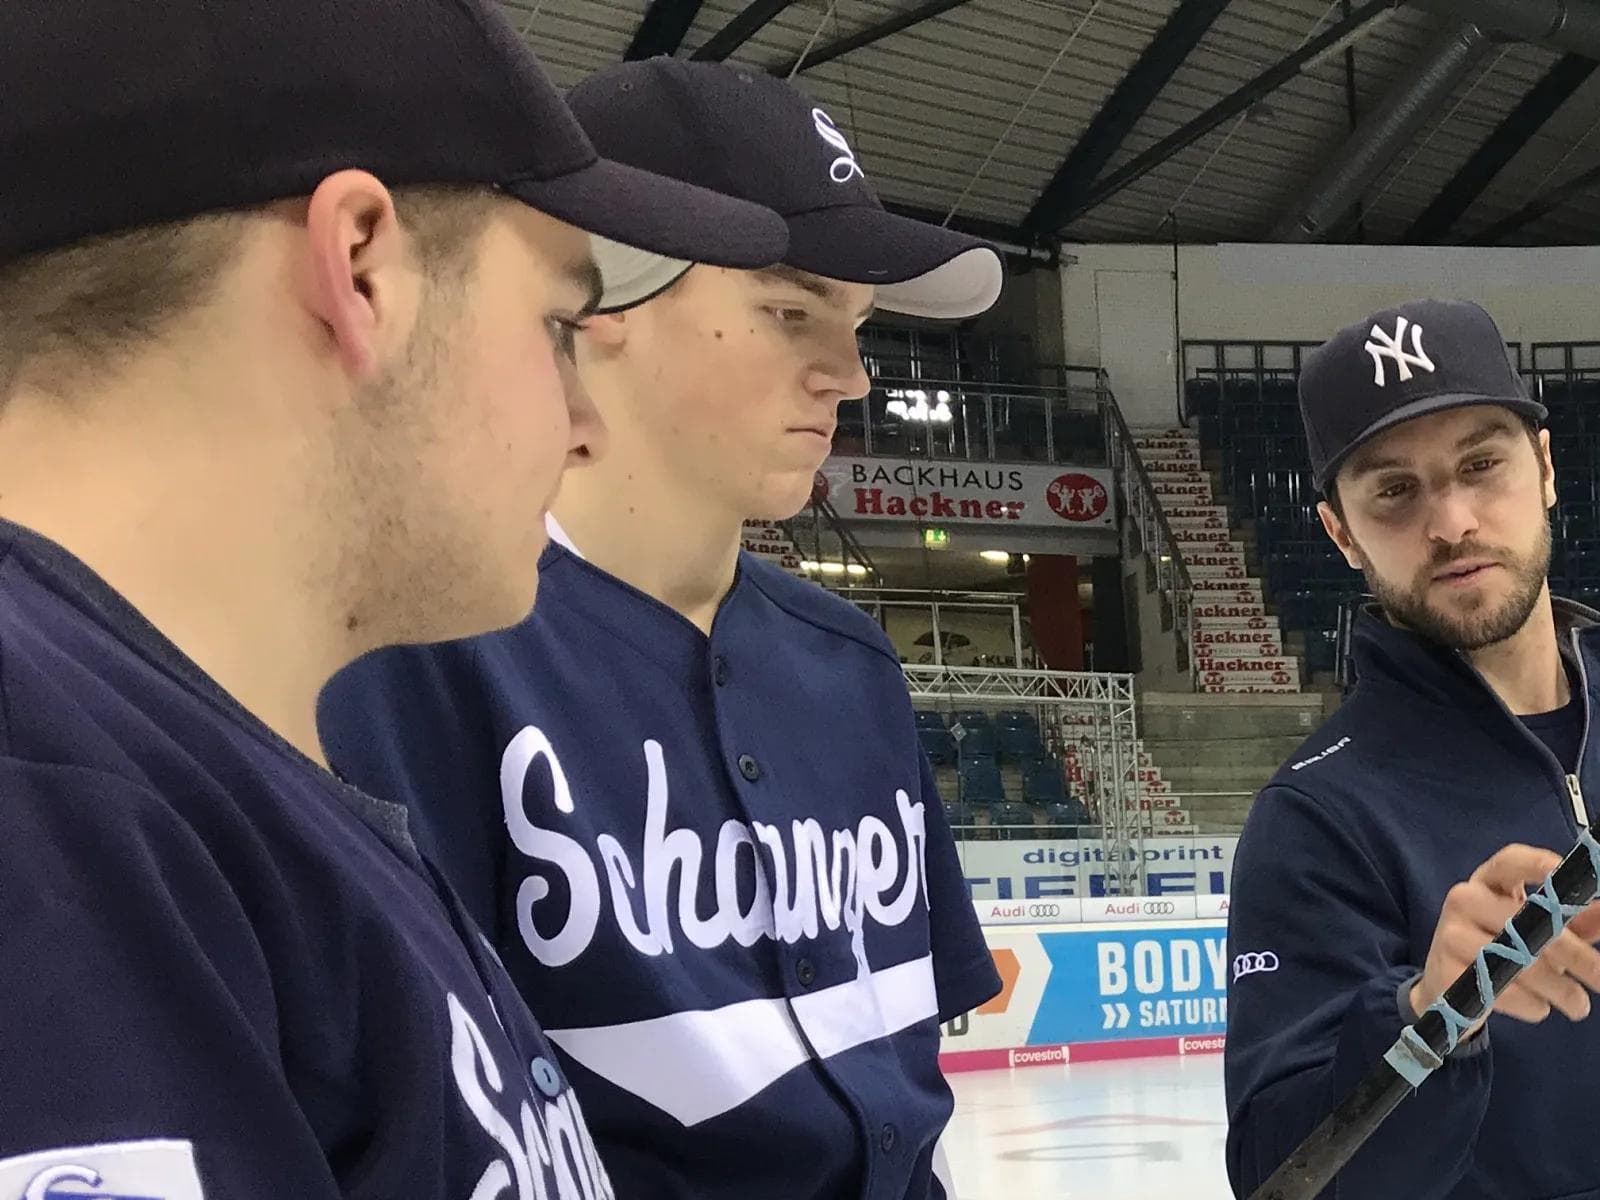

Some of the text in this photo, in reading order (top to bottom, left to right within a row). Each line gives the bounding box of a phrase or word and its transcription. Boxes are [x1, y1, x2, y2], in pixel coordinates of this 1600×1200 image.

[852, 464, 1023, 491] BACKHAUS
[854, 488, 1025, 520] Hackner
[1194, 605, 1261, 617] ackner
[1199, 659, 1285, 671] Hackner
[991, 906, 1025, 918] Audi
[1105, 903, 1140, 915] Audi
[1097, 938, 1227, 995] BODY
[1013, 1050, 1063, 1063] covestro
